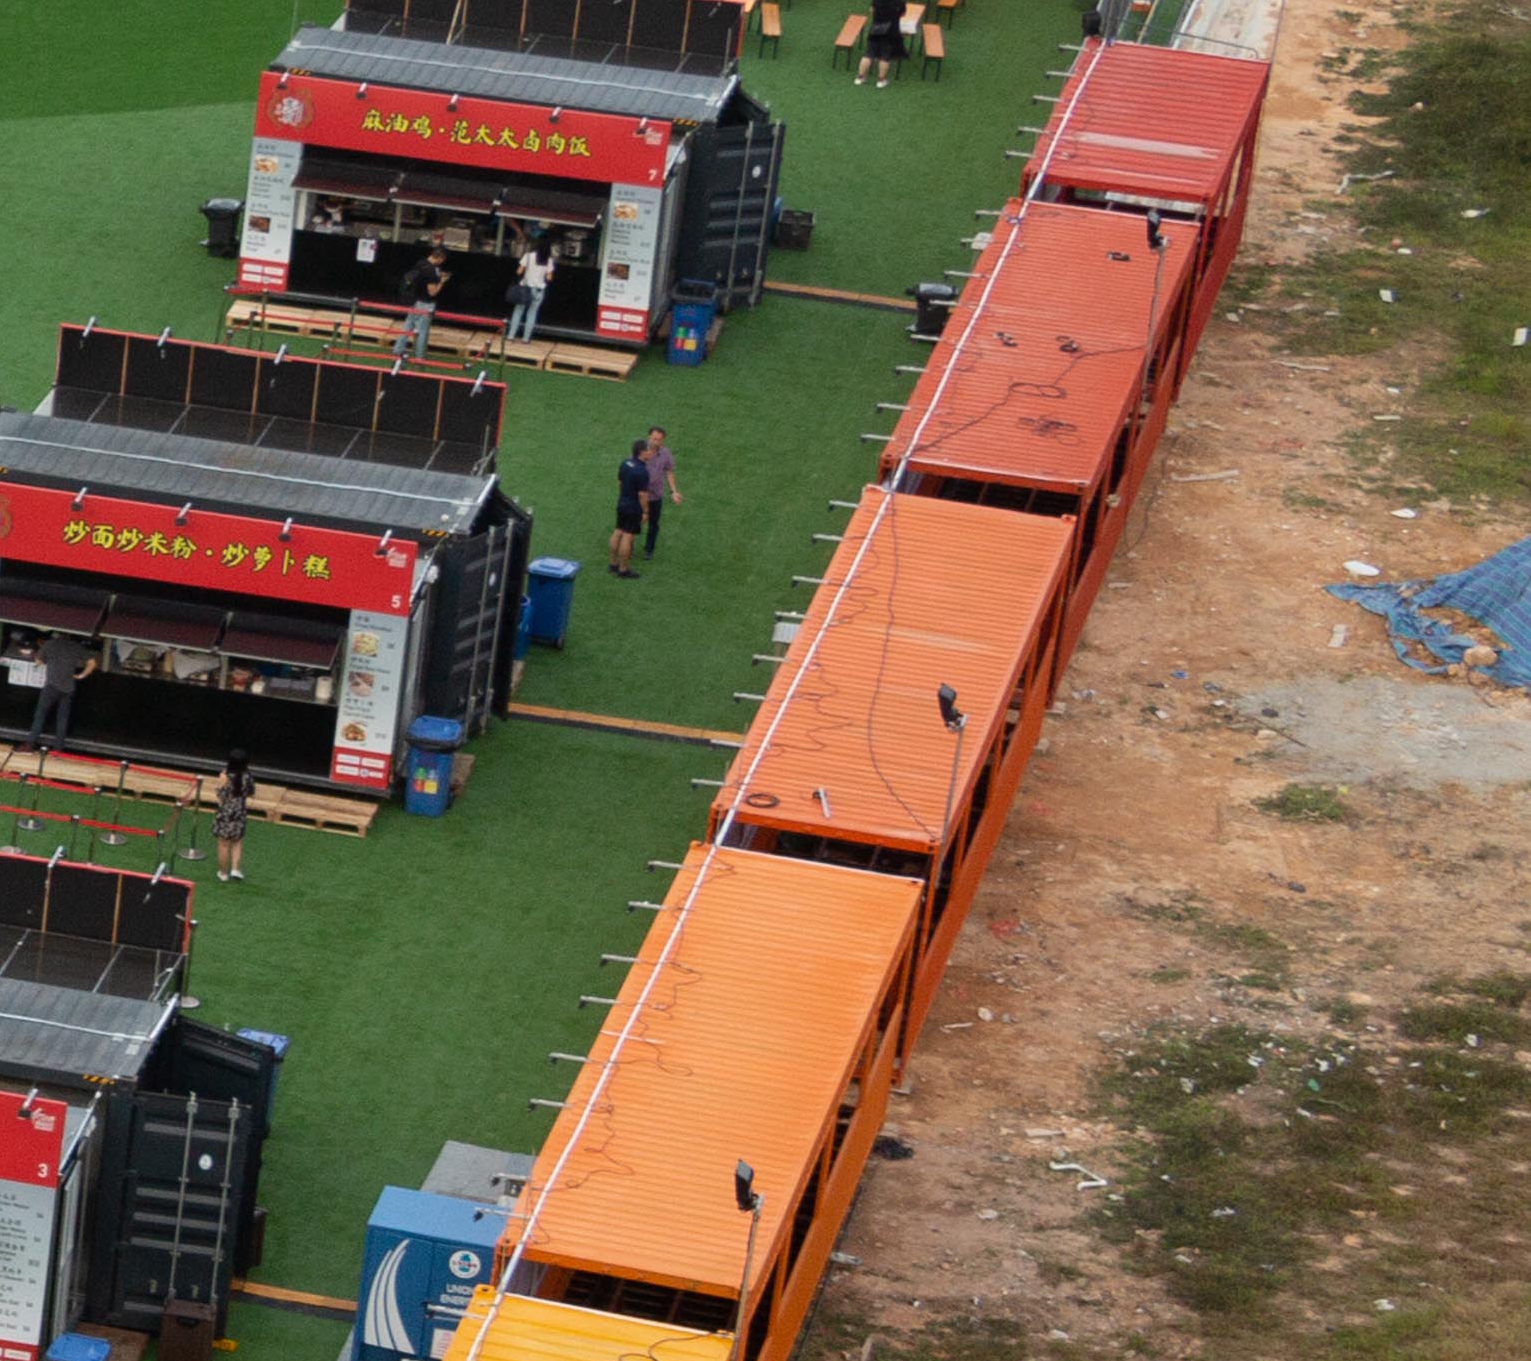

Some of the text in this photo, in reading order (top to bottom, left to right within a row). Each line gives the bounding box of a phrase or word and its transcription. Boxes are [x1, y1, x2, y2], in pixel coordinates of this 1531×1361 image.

[647, 167, 659, 181] 7
[390, 594, 404, 610] 5
[36, 1162, 50, 1179] 3
